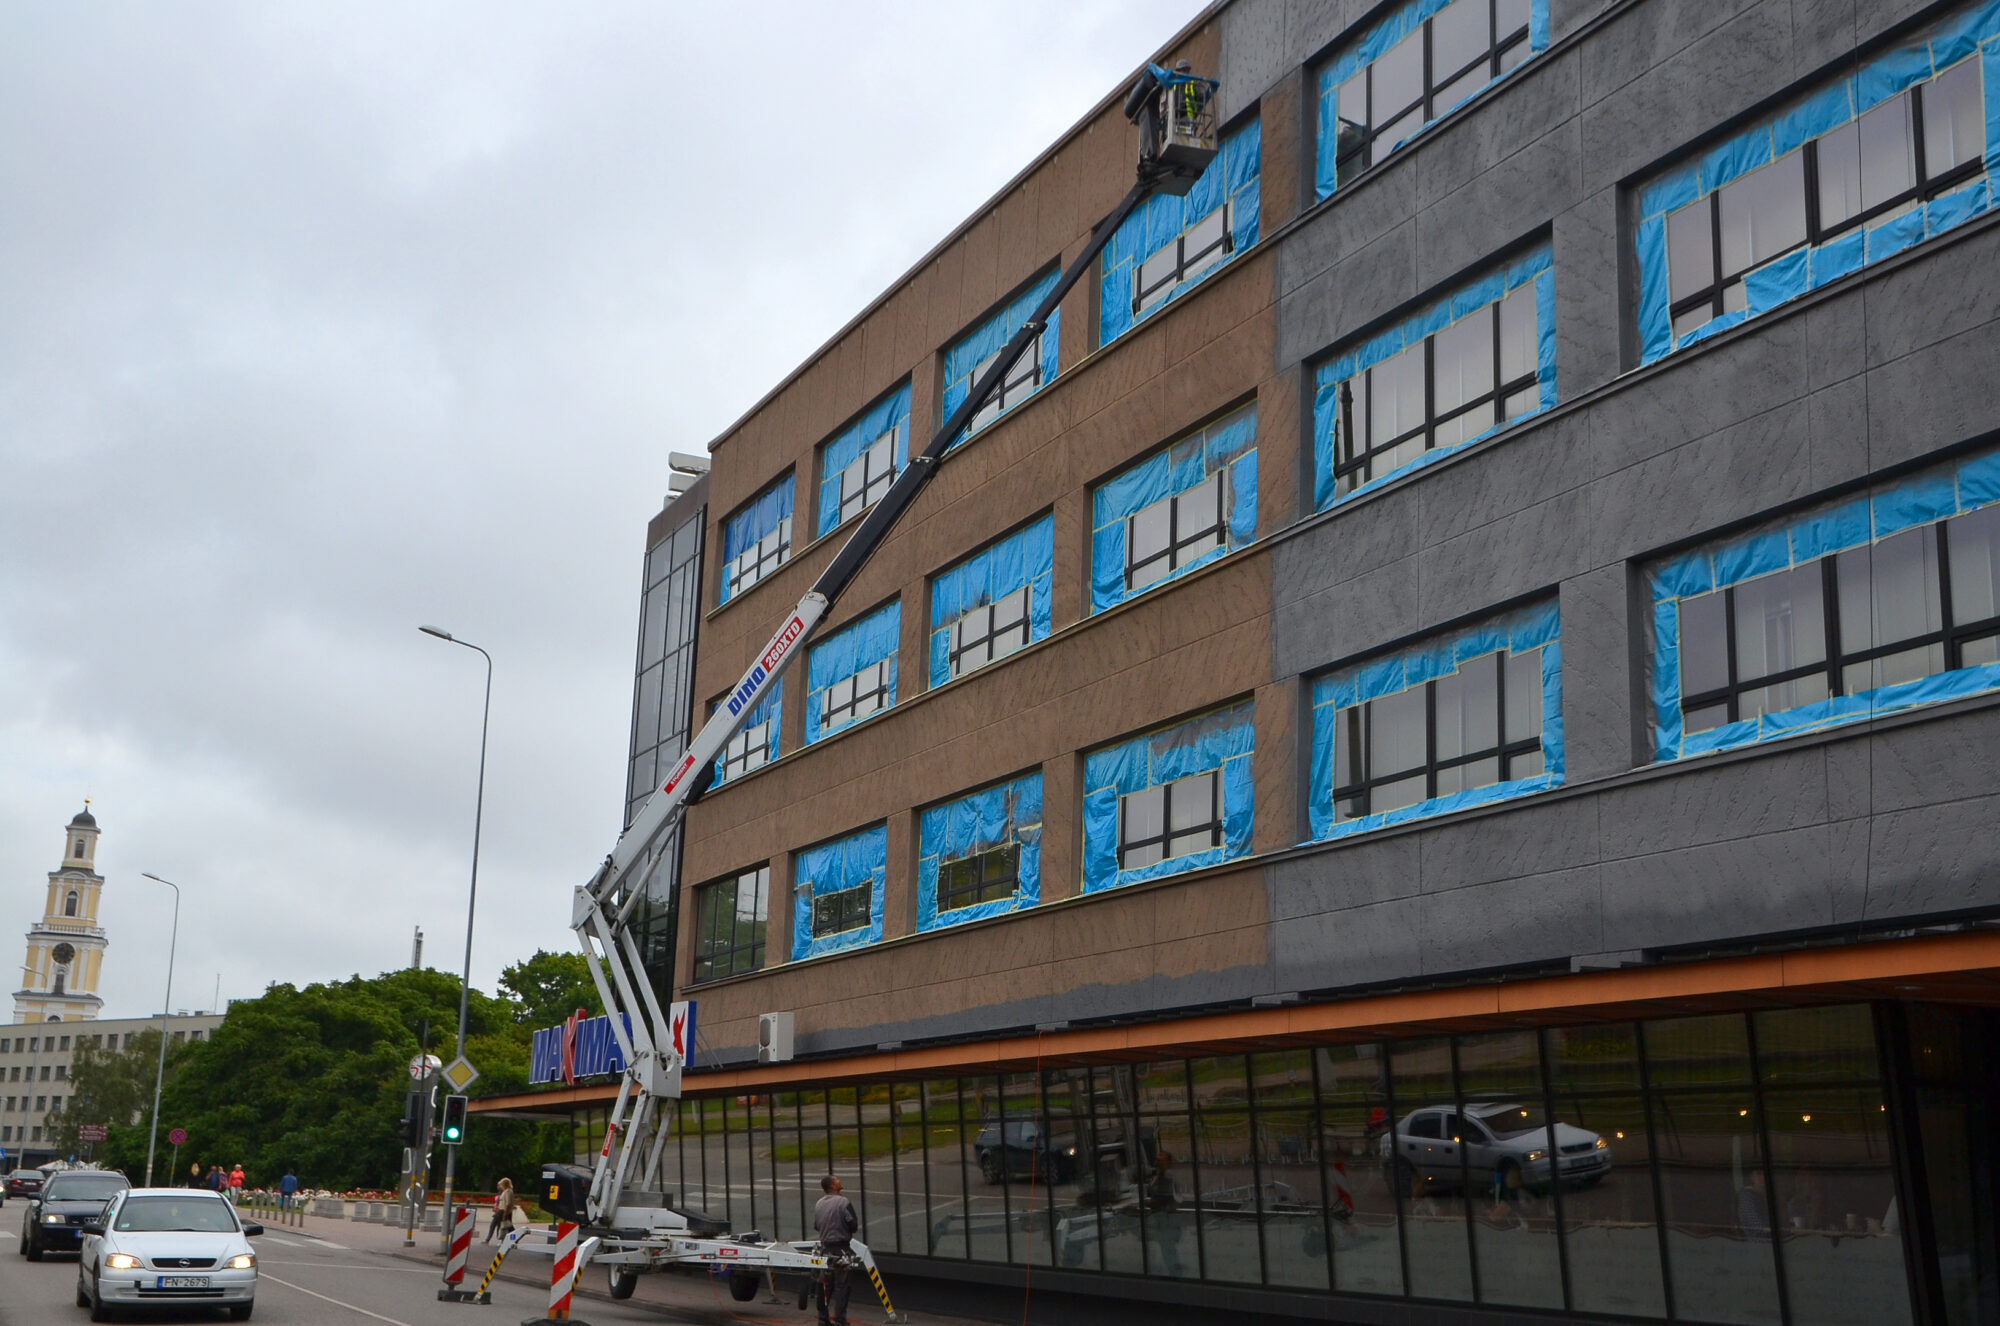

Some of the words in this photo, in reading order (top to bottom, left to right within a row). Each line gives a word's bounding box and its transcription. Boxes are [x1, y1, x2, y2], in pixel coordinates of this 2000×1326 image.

[727, 666, 766, 717] DINO
[765, 621, 801, 669] 260XTD
[529, 1008, 634, 1086] MAXIMA
